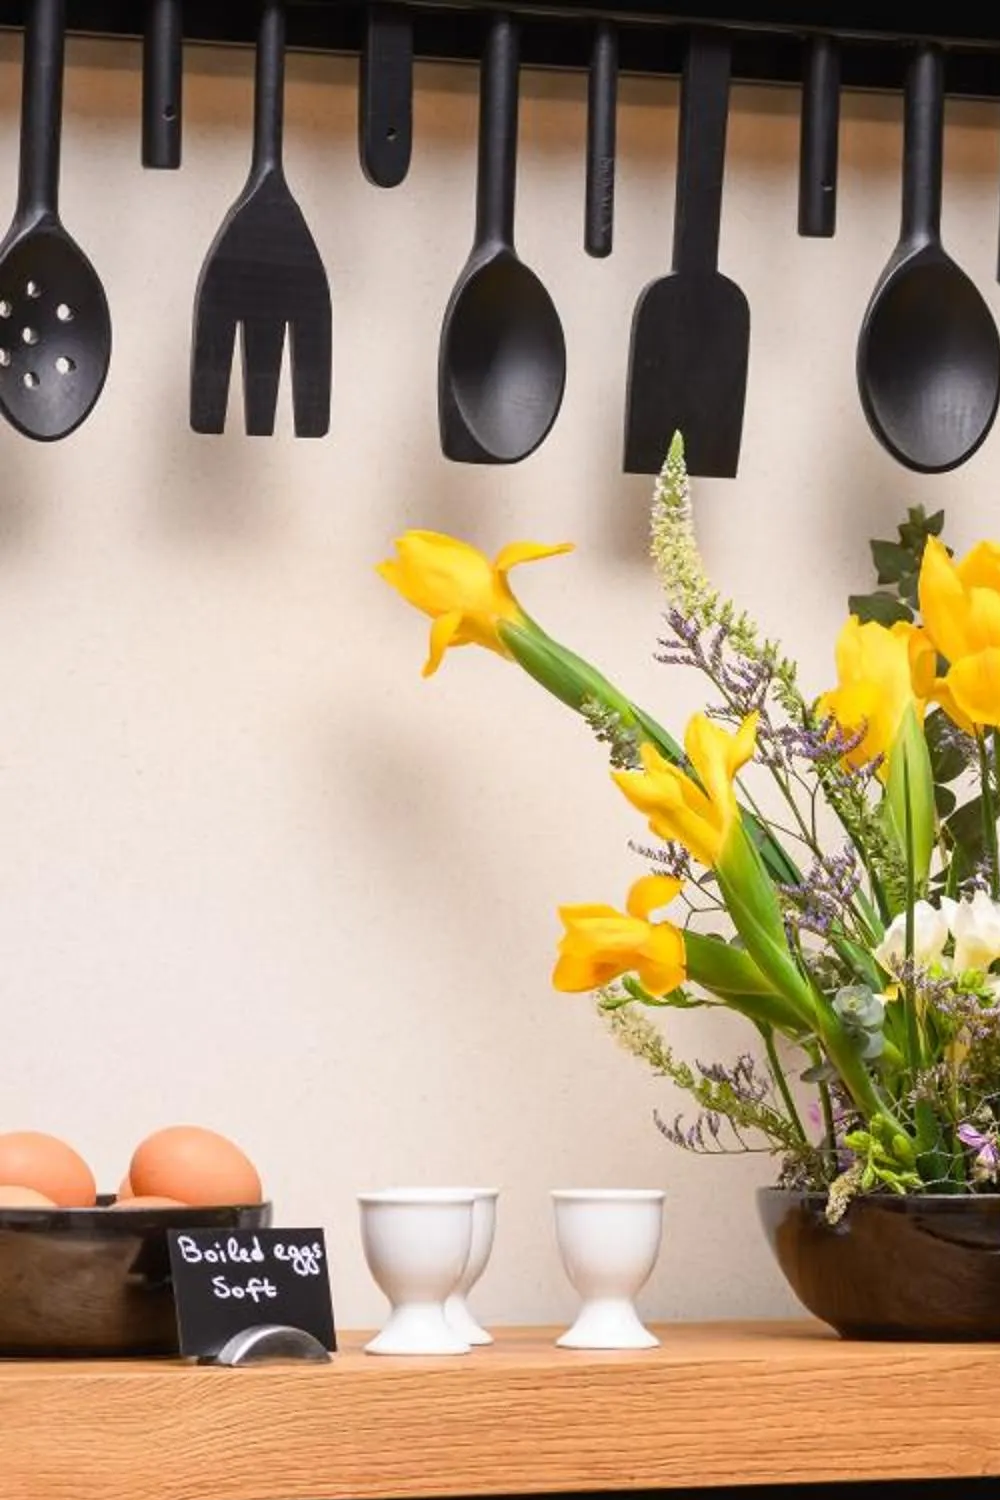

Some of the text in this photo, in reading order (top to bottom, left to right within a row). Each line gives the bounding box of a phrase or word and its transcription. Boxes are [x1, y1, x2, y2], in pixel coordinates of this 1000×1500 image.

[177, 1235, 323, 1276] Boiled eggs
[211, 1275, 278, 1303] Soft
